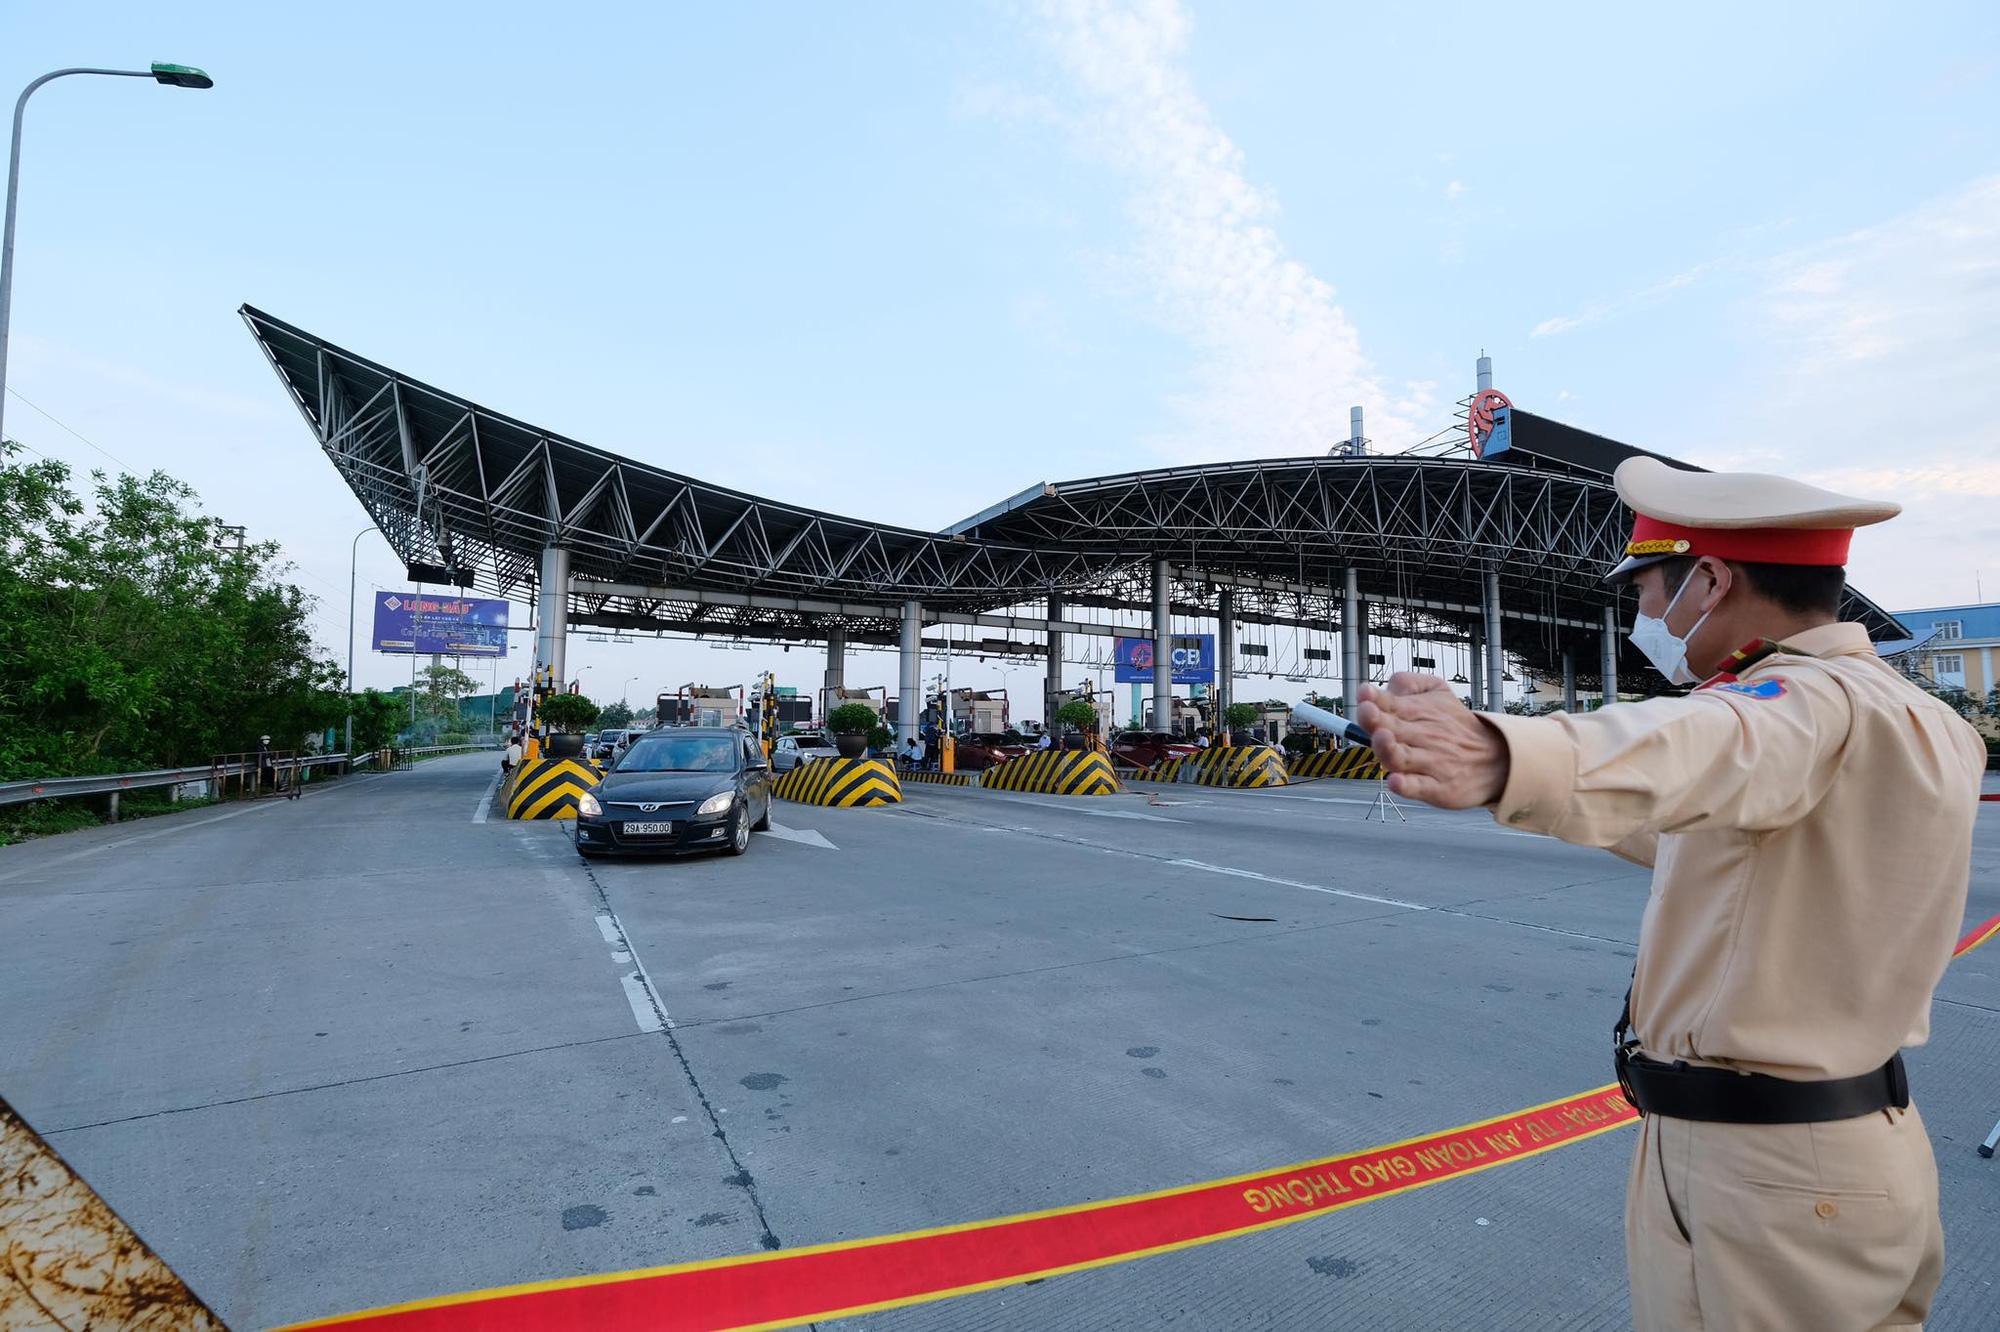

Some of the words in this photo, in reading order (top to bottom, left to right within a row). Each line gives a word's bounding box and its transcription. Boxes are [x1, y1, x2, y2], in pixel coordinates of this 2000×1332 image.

[1350, 1155, 1417, 1187] GIAO
[1414, 1138, 1488, 1171] TOÀN
[1243, 1171, 1352, 1212] THÔNG
